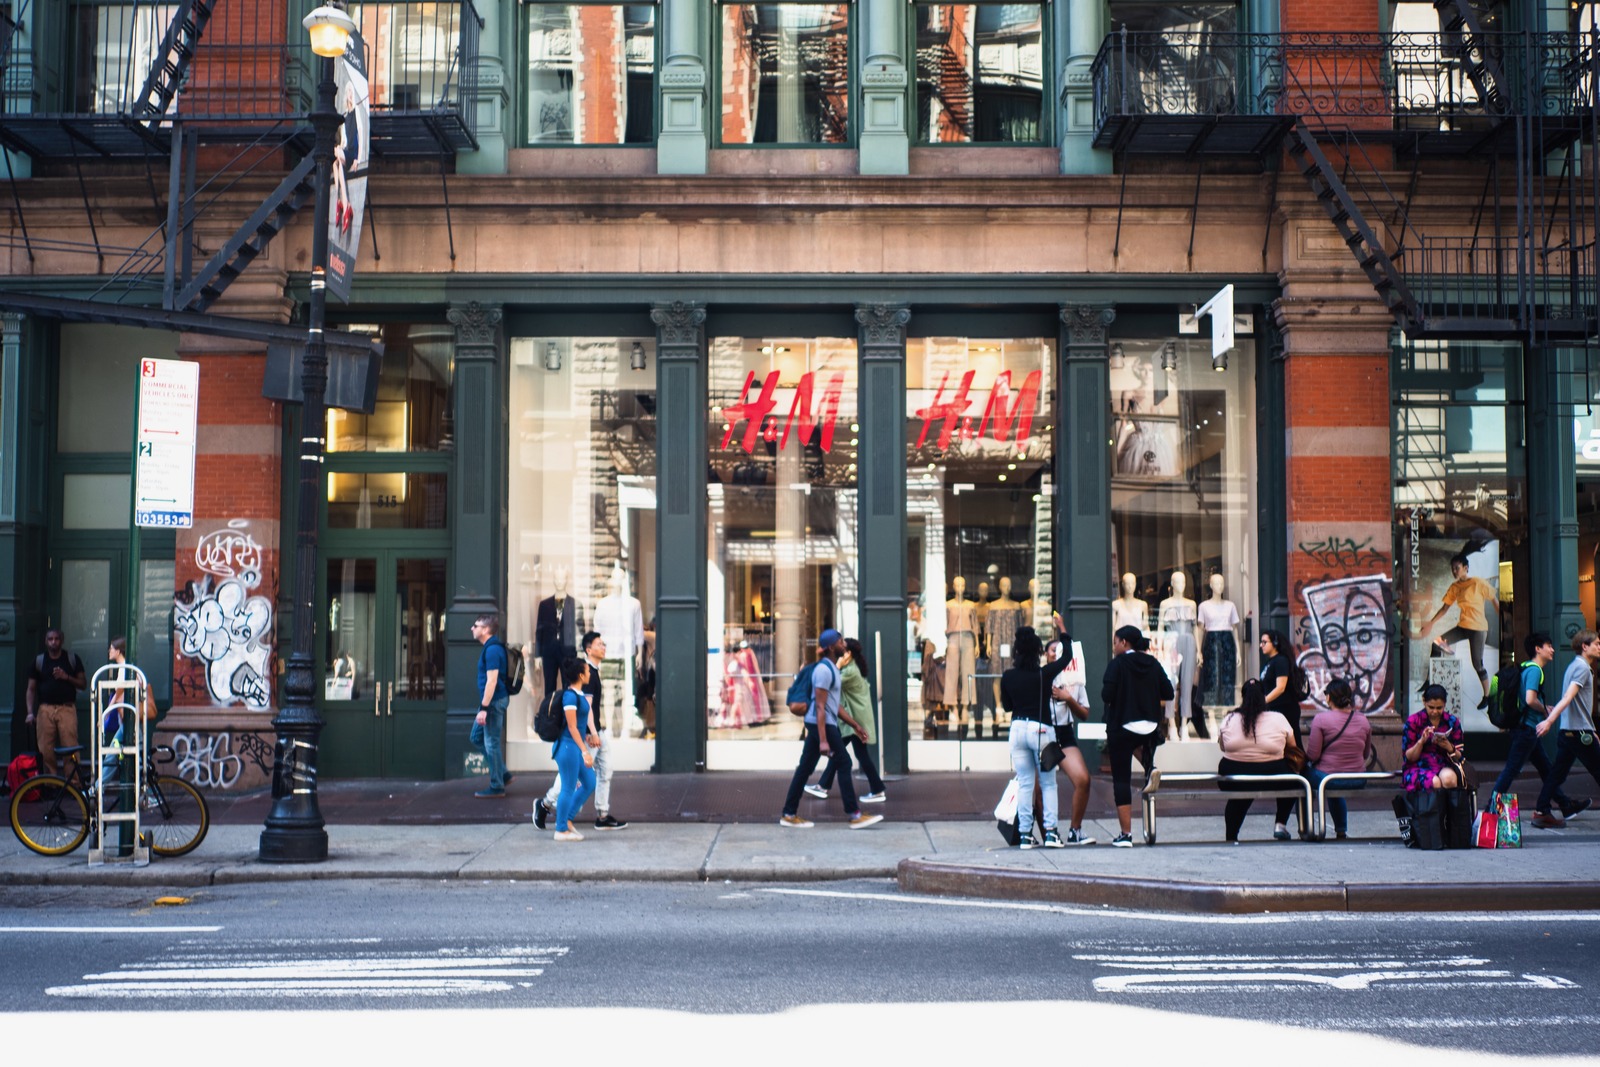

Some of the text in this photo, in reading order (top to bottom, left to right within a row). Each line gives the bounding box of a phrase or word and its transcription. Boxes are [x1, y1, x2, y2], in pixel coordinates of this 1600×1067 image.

[144, 361, 155, 378] 3
[143, 382, 187, 391] COMMERCIAL
[143, 391, 176, 399] VEHICLES
[721, 370, 846, 454] H&M
[915, 369, 1042, 453] H&M
